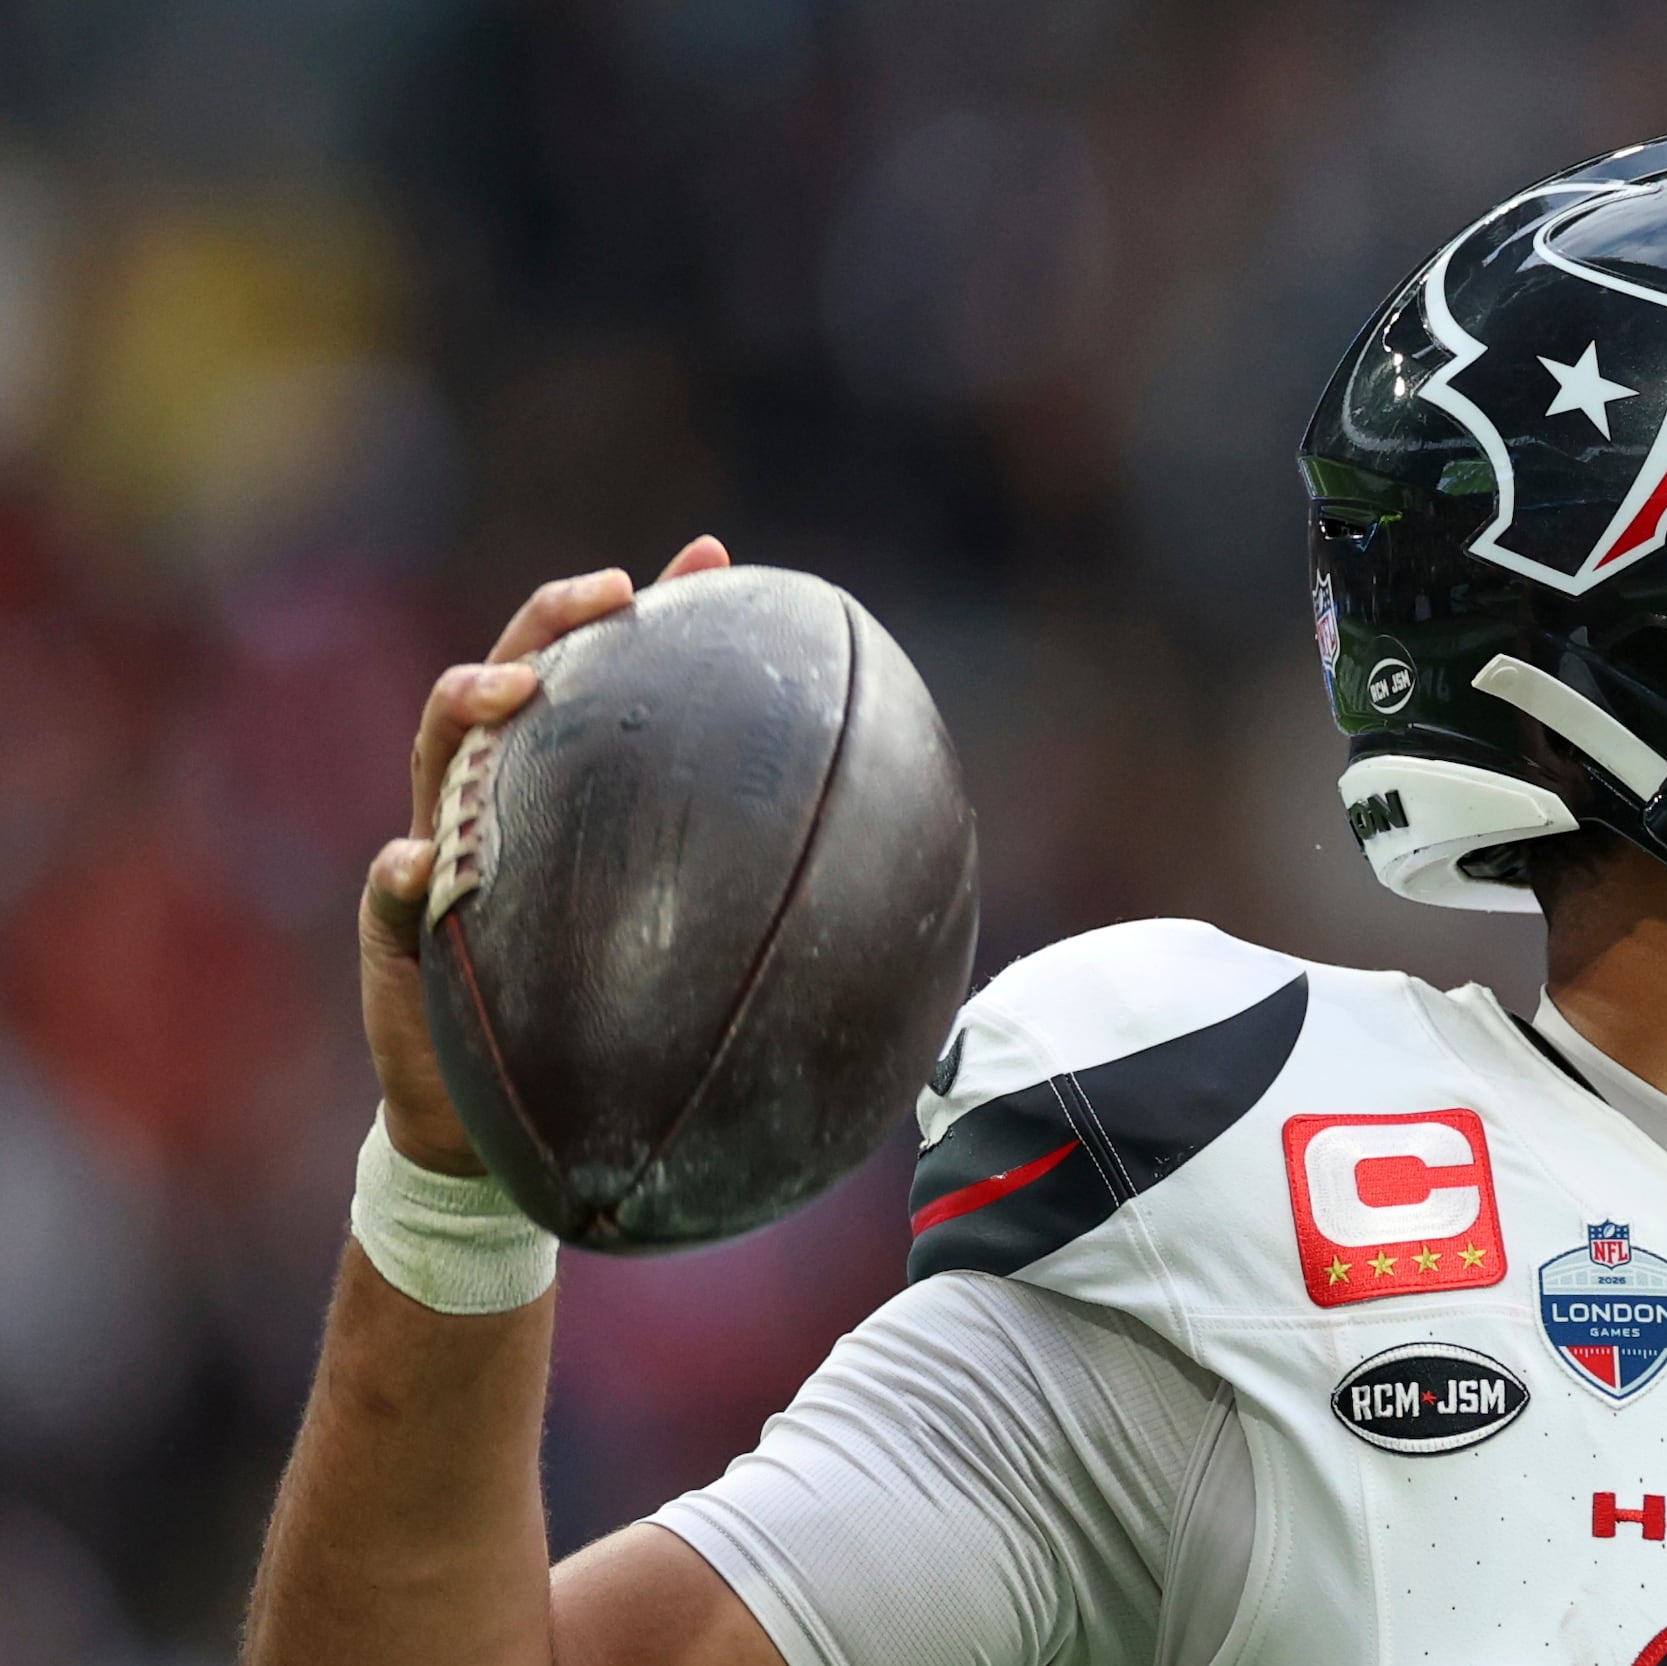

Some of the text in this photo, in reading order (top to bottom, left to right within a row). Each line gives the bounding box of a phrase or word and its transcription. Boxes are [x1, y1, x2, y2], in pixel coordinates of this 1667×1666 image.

[1369, 669, 1412, 703] RCM JSM
[1347, 788, 1410, 841] ON
[1303, 1122, 1482, 1248] C
[1592, 1240, 1629, 1264] NFL
[1597, 1276, 1627, 1285] 2026
[1590, 1328, 1641, 1338] GAMES
[1351, 1379, 1506, 1422] RCM JSM
